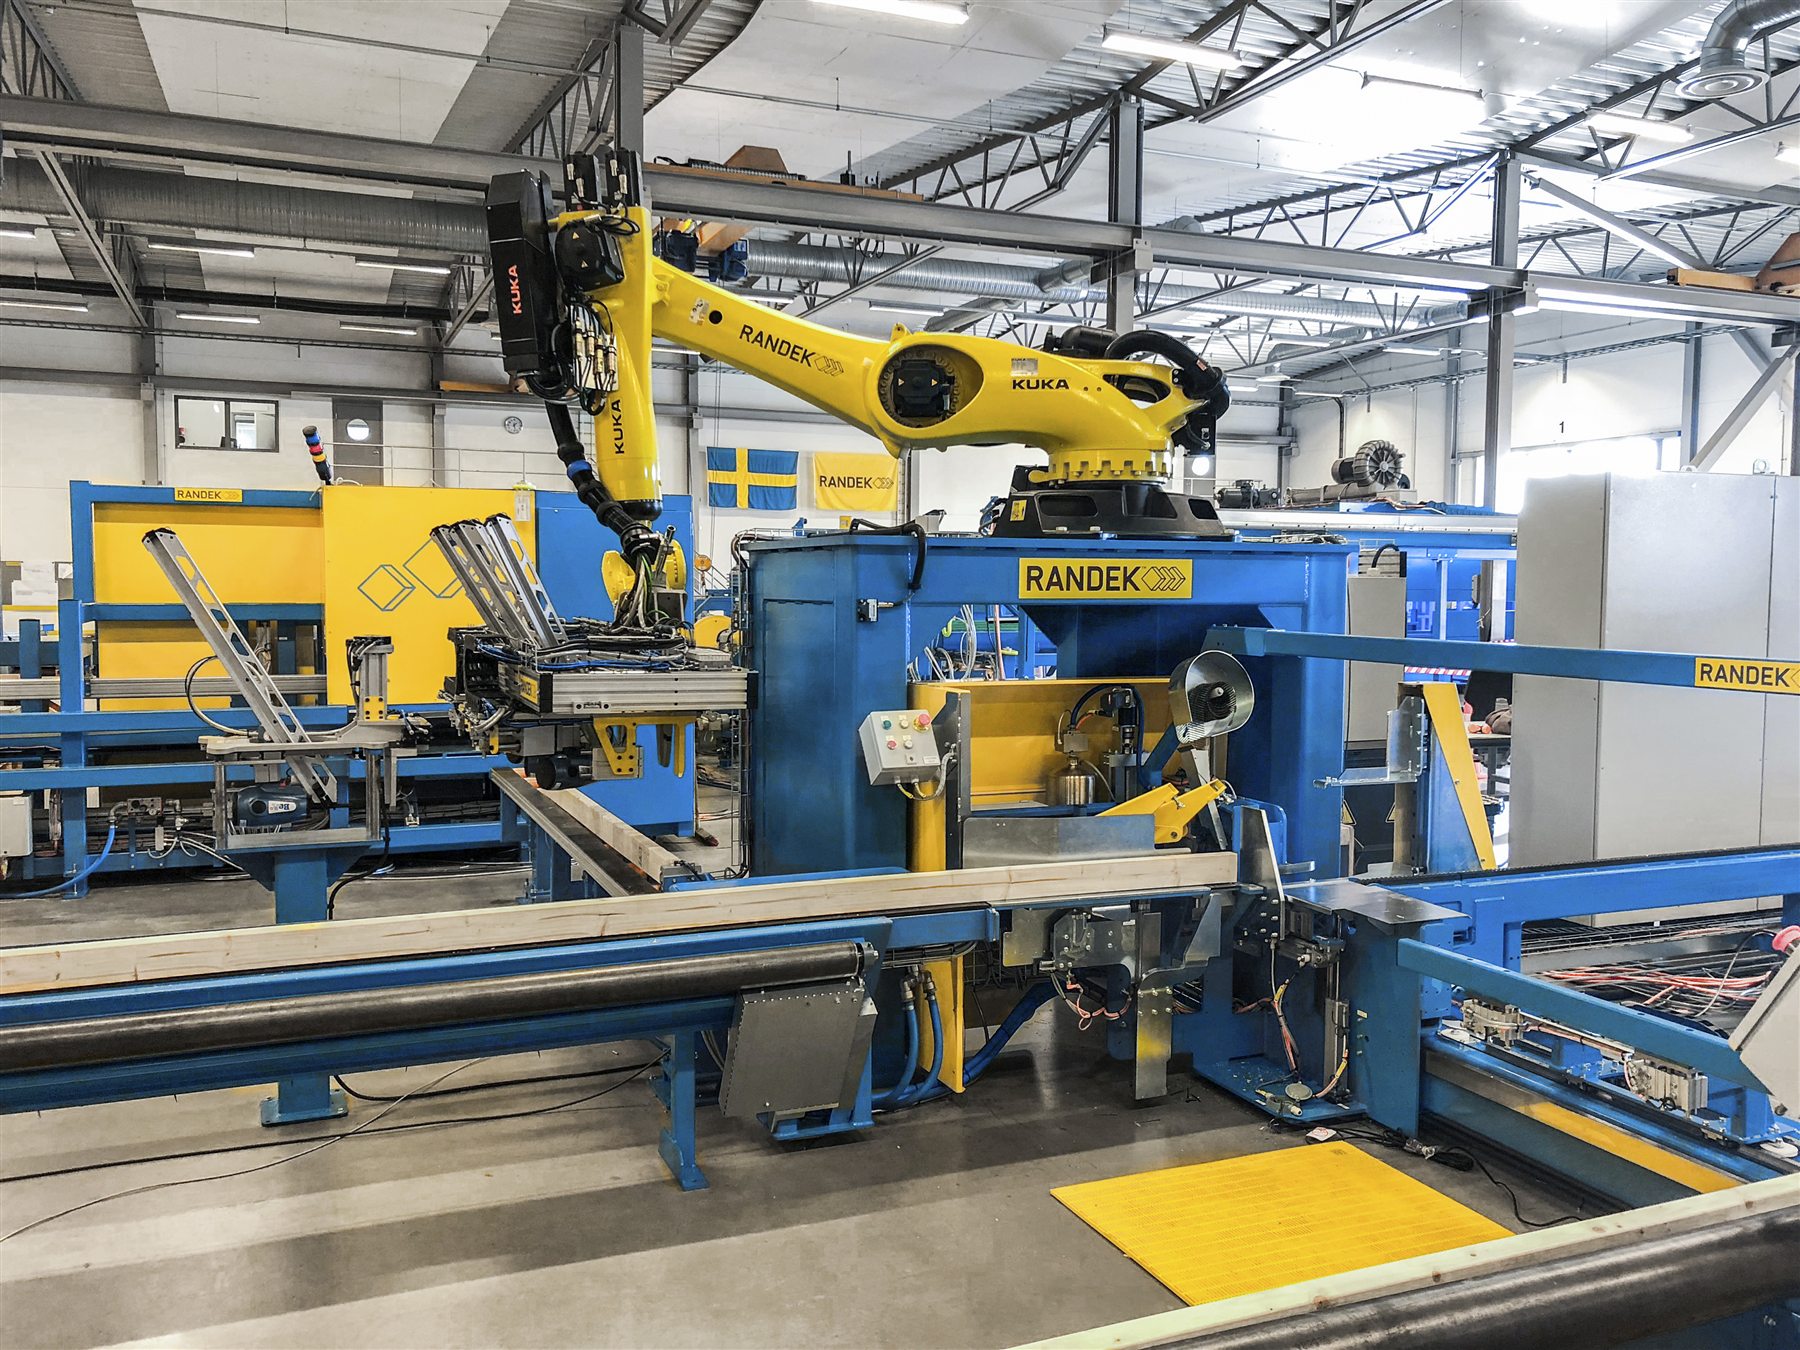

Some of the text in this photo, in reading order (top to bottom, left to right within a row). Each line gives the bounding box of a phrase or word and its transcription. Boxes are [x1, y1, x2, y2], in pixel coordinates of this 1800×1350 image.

[508, 264, 523, 315] KUKA
[739, 324, 816, 368] RANDEK
[1012, 379, 1069, 390] KUKA
[611, 399, 625, 454] KUKA
[1559, 421, 1564, 434] 1
[819, 475, 873, 489] RANDEK
[177, 490, 222, 499] RANDEK
[1026, 565, 1141, 591] RANDEK
[1700, 663, 1790, 687] RANDEK
